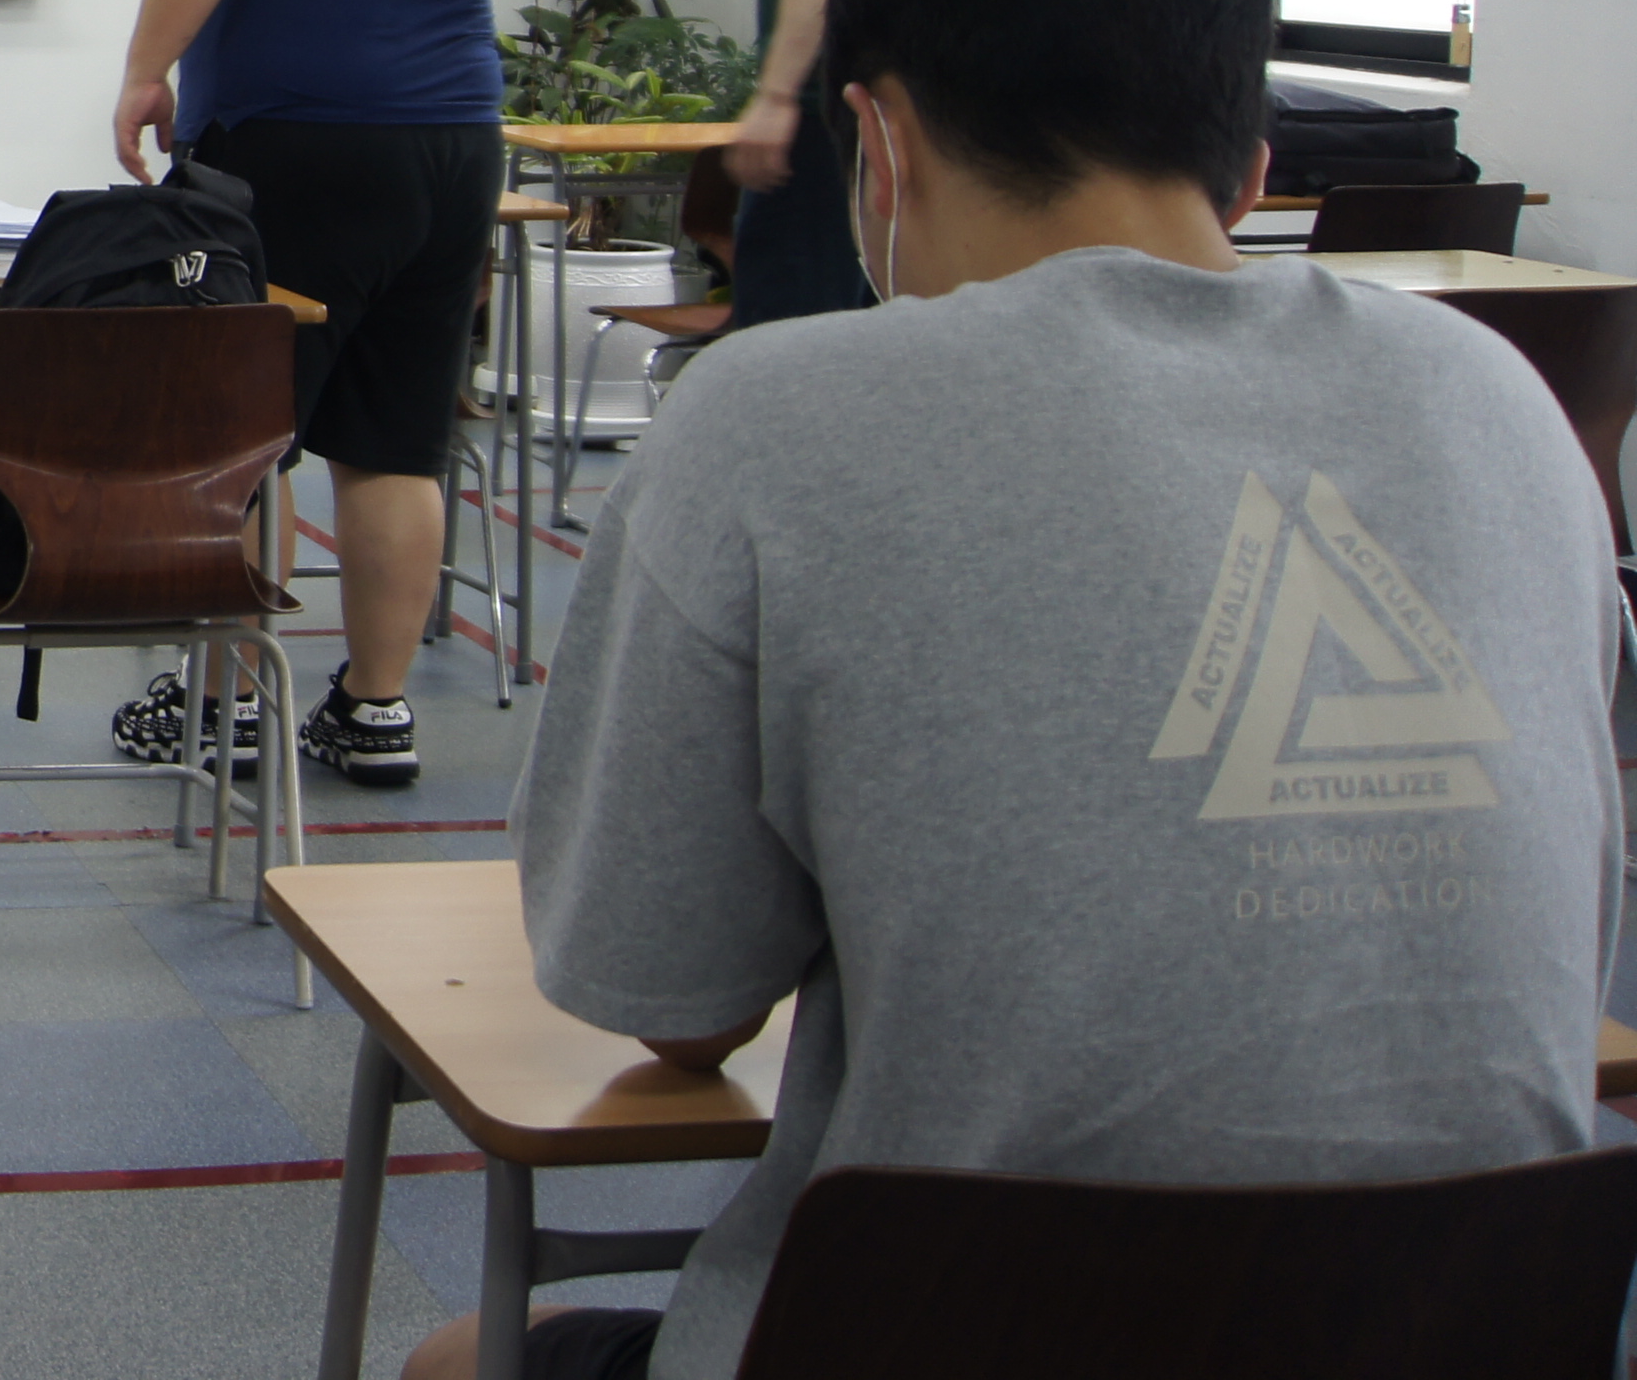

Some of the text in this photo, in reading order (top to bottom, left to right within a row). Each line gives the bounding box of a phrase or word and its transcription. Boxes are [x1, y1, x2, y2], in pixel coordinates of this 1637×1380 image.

[1189, 533, 1263, 711] ACTUALIZE
[1333, 532, 1471, 695] ACTUALIZE
[237, 705, 259, 718] FIL
[370, 710, 404, 723] FILA
[1269, 770, 1450, 805] ACTUALIZE
[1248, 831, 1468, 870] HARDWORK
[1235, 876, 1494, 920] DEDICATION
